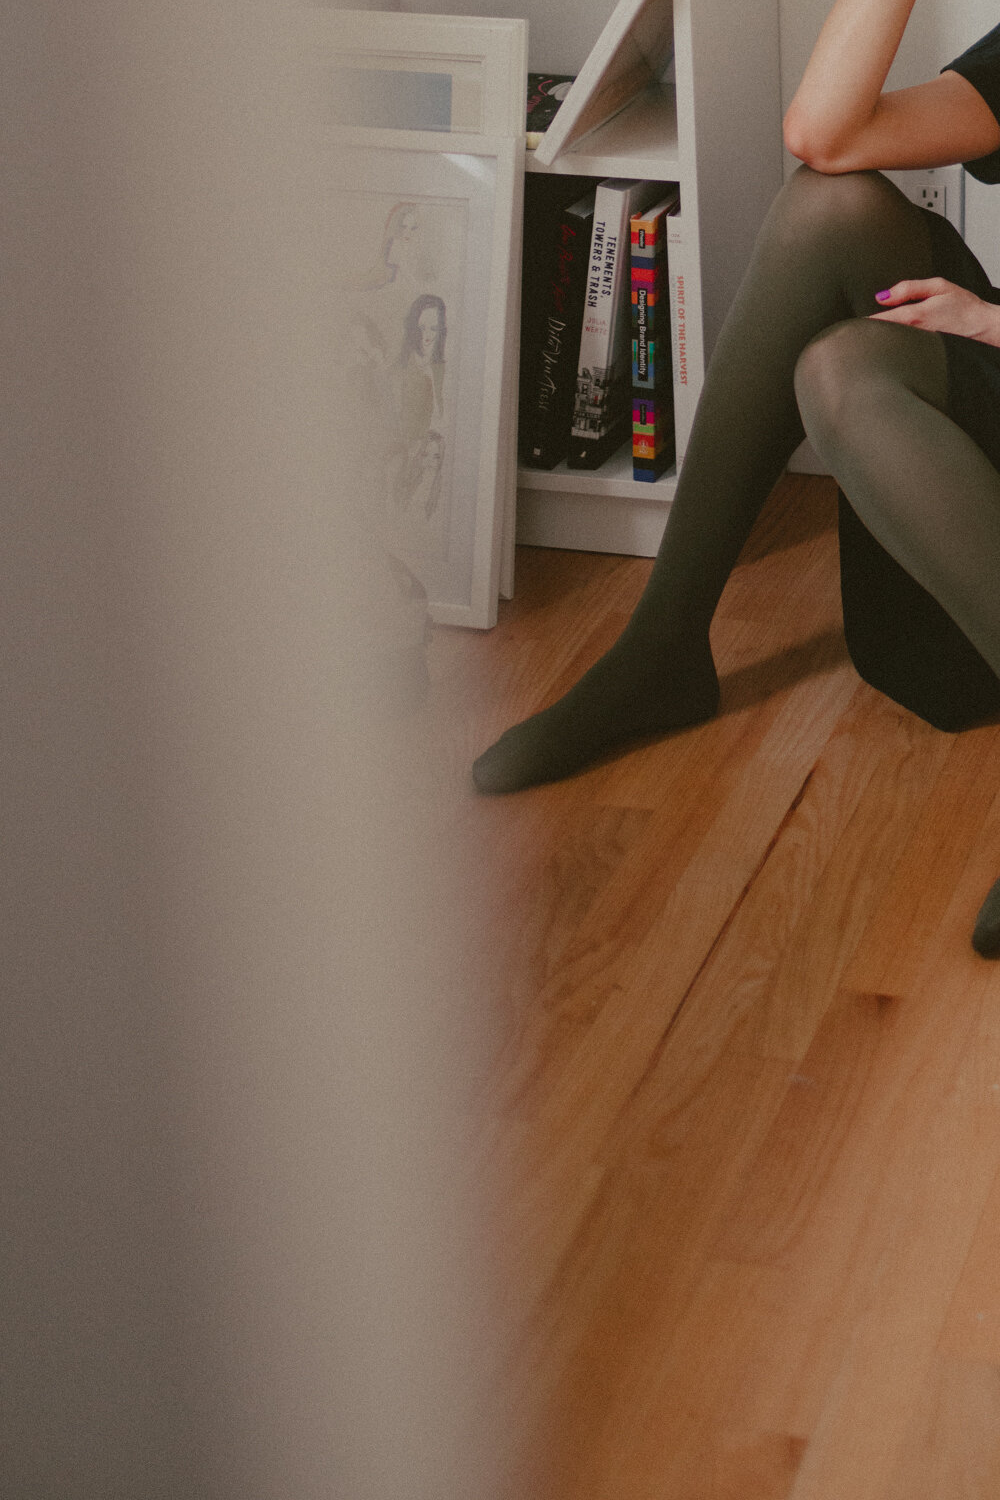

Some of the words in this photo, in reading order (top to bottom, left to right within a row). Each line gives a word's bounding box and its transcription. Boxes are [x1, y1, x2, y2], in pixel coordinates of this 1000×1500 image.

[593, 220, 606, 264] TOWERS
[601, 236, 617, 299] TENEMENTS,
[587, 274, 598, 308] TRASH
[677, 275, 685, 304] SPIRIT
[637, 289, 647, 325] Designing
[678, 307, 686, 319] OF
[637, 325, 647, 347] Brand
[678, 322, 686, 340] THE
[637, 348, 647, 375] Identity
[679, 342, 688, 385] HARVEST
